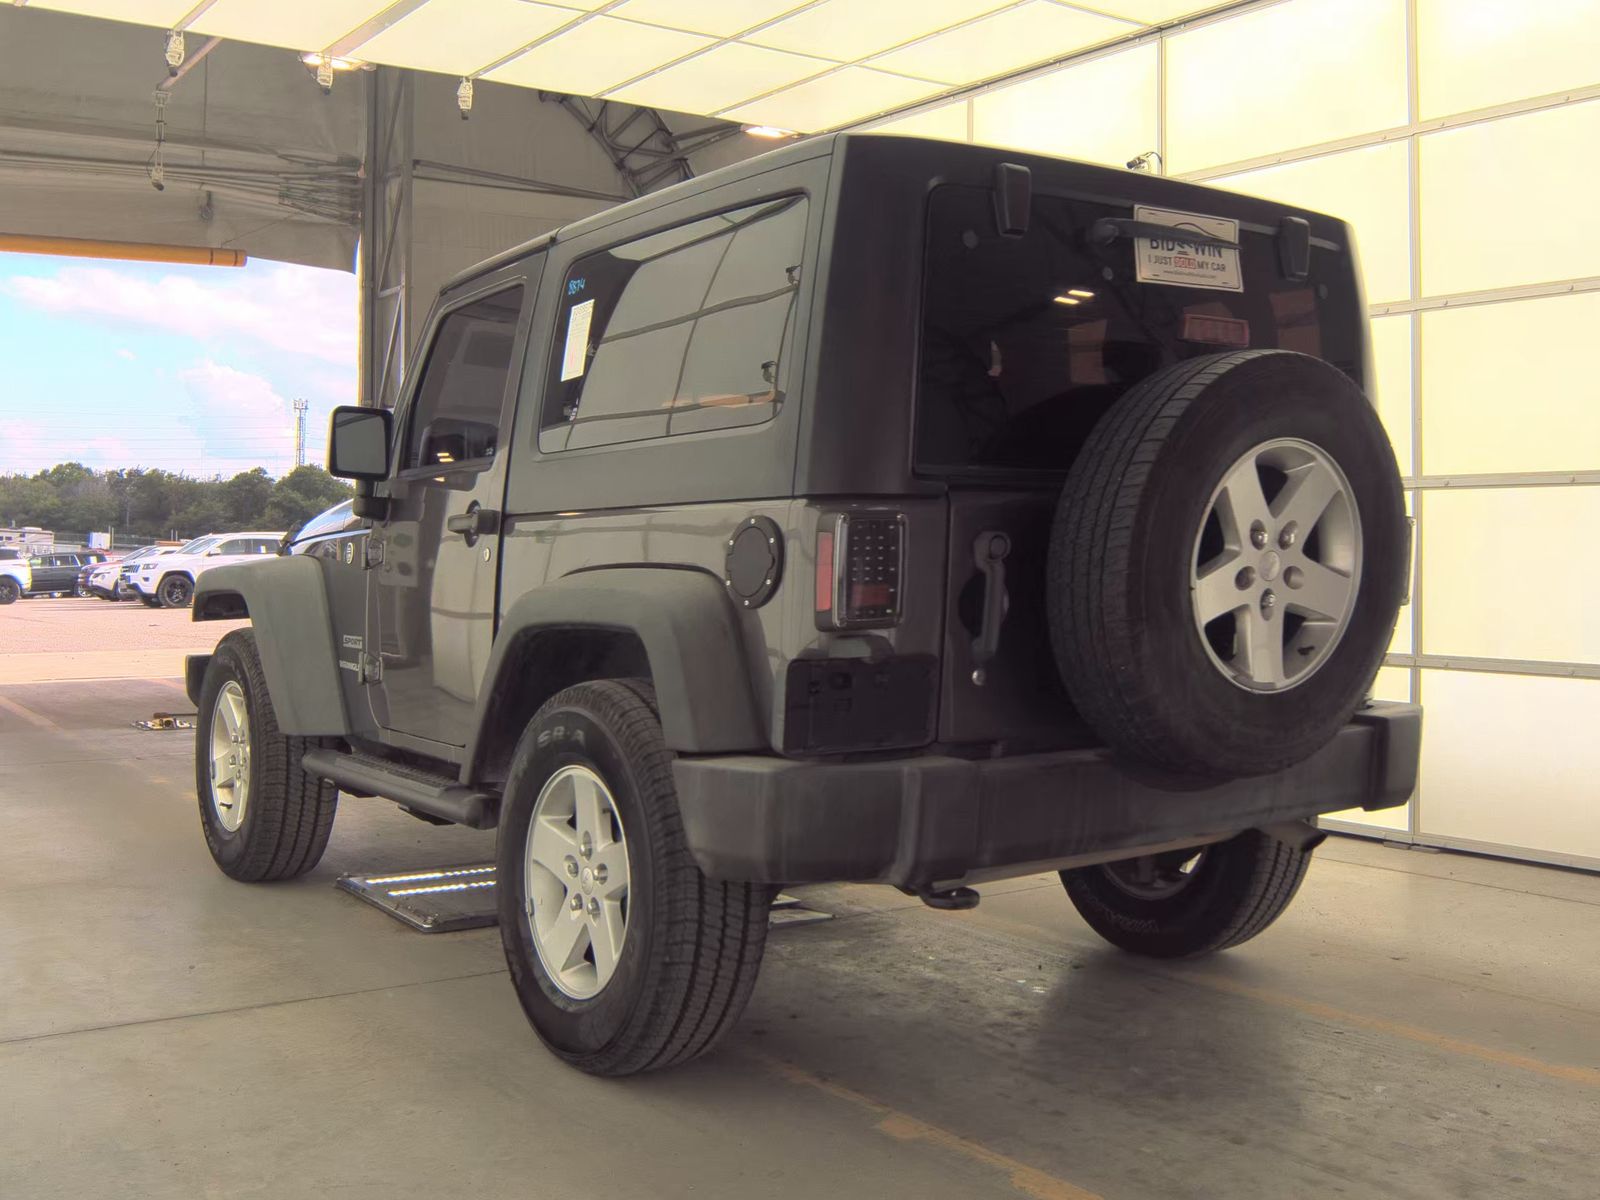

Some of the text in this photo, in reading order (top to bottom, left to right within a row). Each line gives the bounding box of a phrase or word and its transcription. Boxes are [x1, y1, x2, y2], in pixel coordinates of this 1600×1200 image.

[1150, 239, 1223, 258] BID WIN
[1153, 255, 1173, 266] JUST
[1174, 256, 1197, 269] SOLD
[1197, 261, 1209, 270] MY
[1211, 262, 1226, 272] CAR
[343, 636, 362, 647] SPORT
